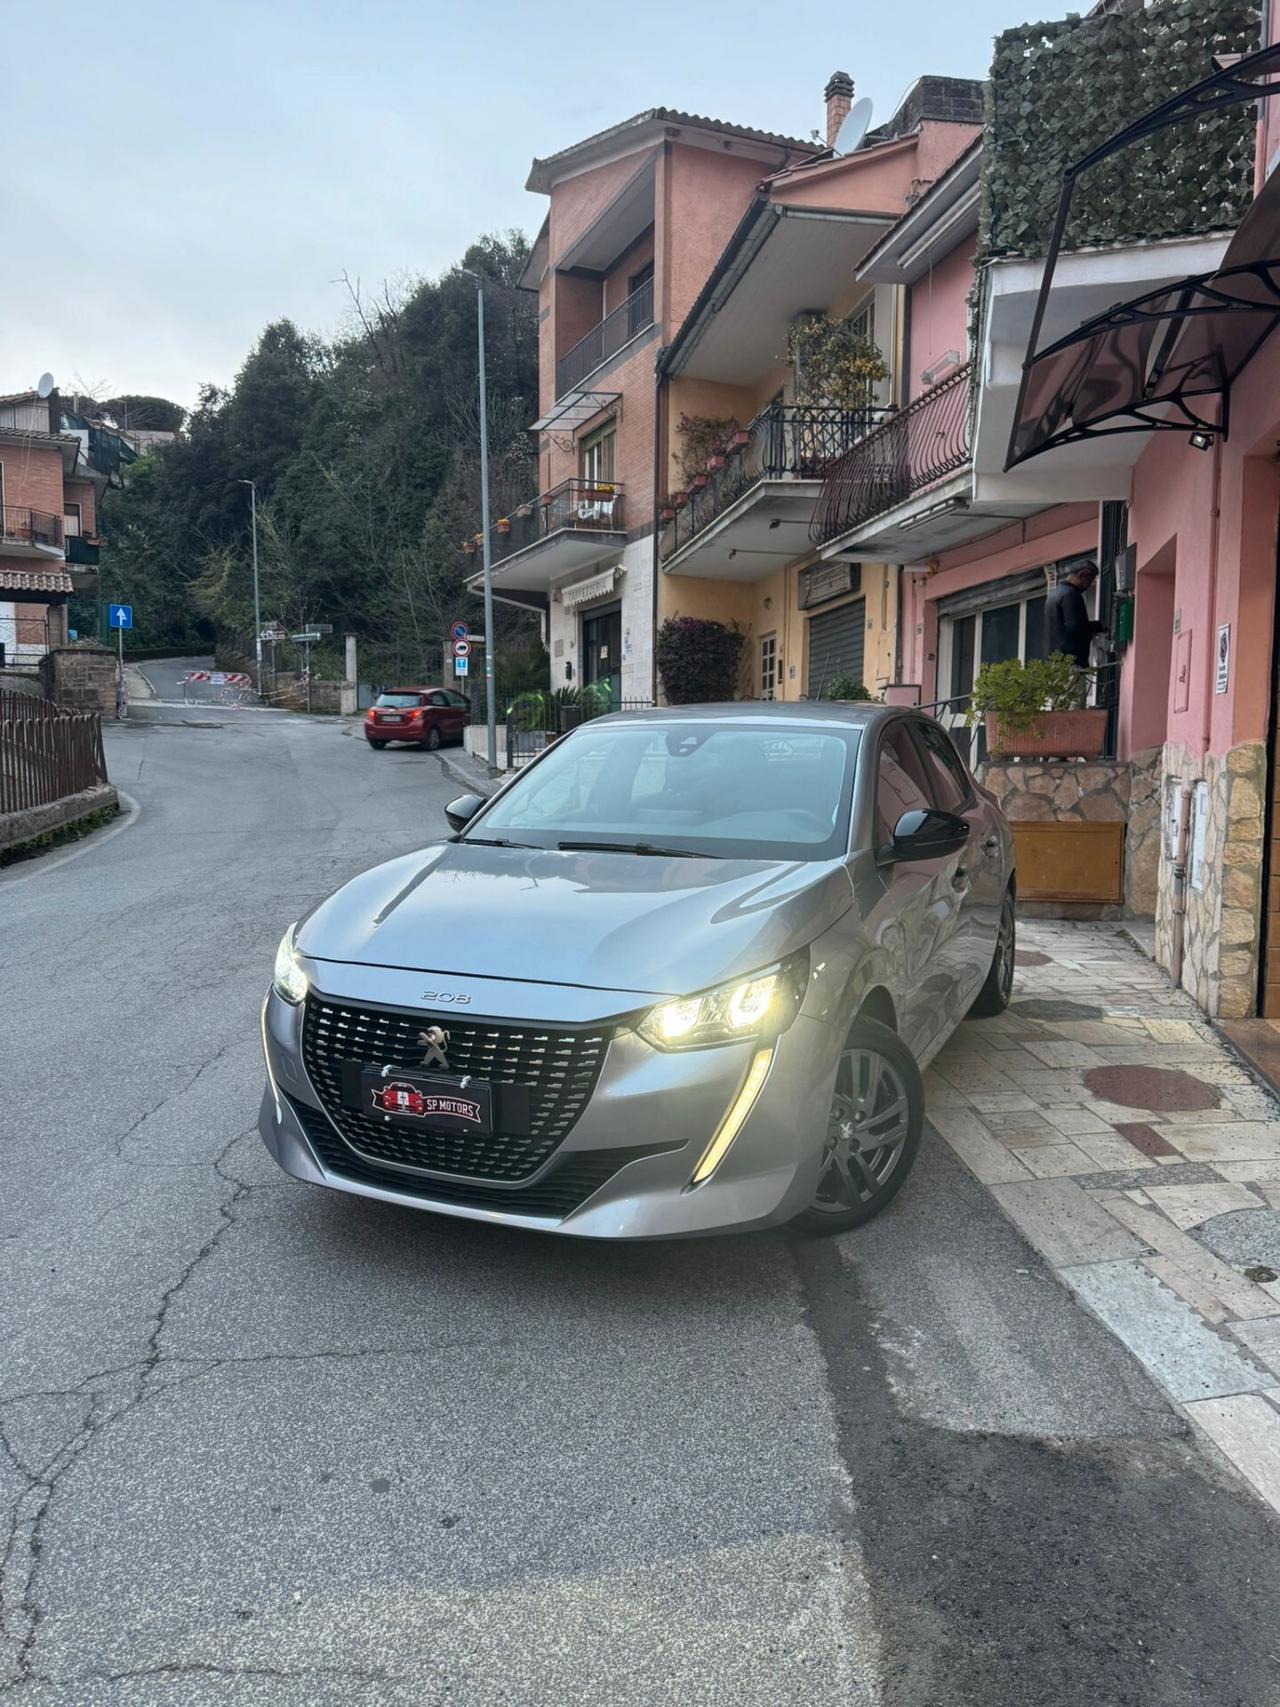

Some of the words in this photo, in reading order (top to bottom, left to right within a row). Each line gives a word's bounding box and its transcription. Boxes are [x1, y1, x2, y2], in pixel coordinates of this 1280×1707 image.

[421, 991, 471, 1004] 208
[427, 1099, 438, 1110] SP
[439, 1100, 474, 1116] MOTORS
